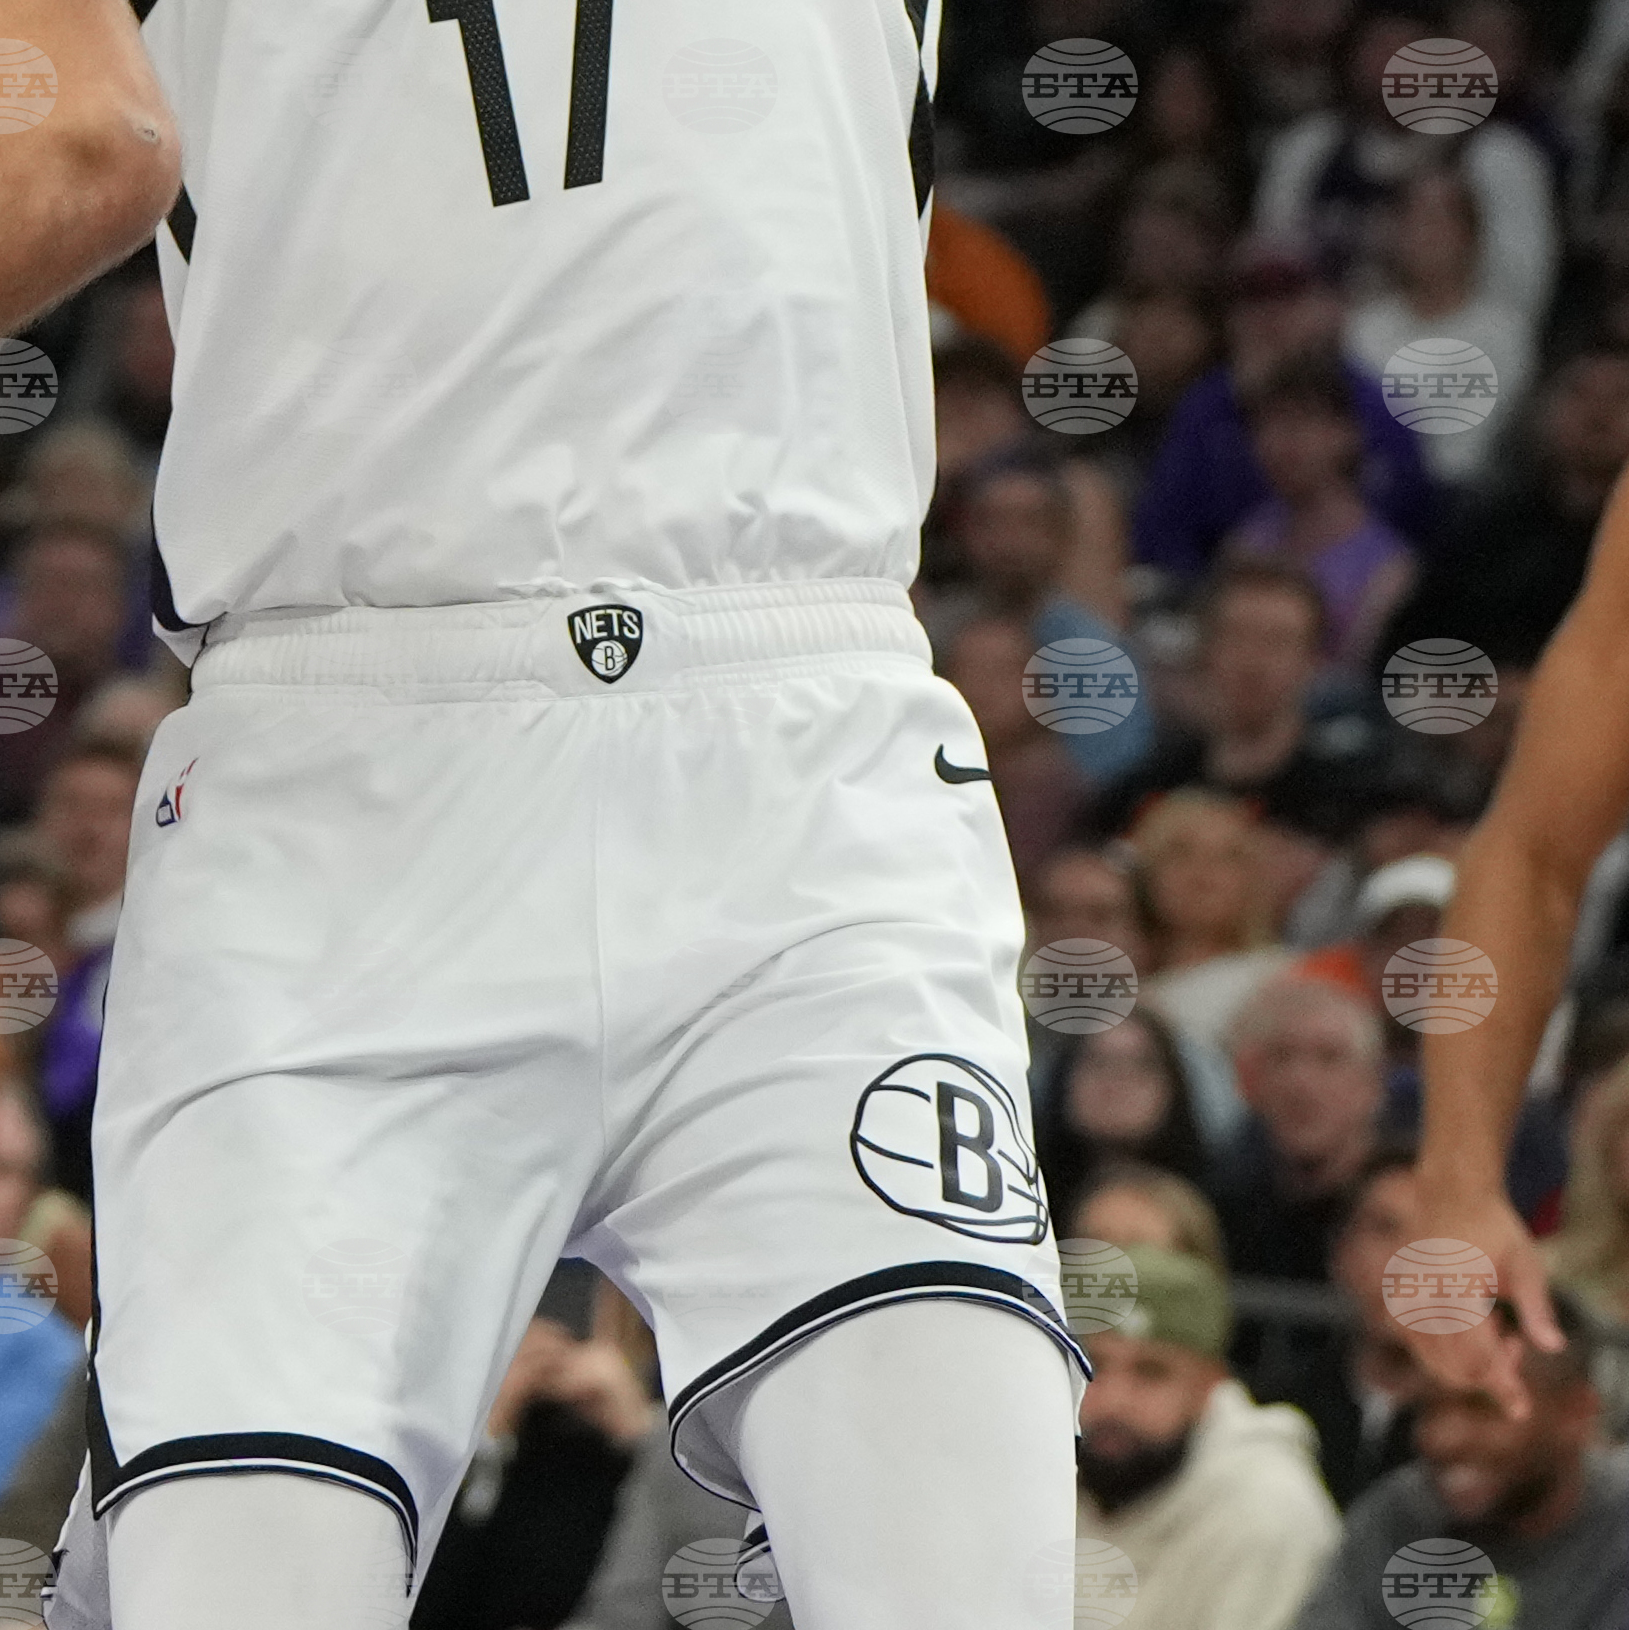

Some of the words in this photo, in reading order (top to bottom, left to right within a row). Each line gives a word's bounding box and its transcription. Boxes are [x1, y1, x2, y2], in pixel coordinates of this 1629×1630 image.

[573, 608, 641, 644] NETS
[604, 645, 616, 671] B
[936, 1081, 1003, 1213] B
